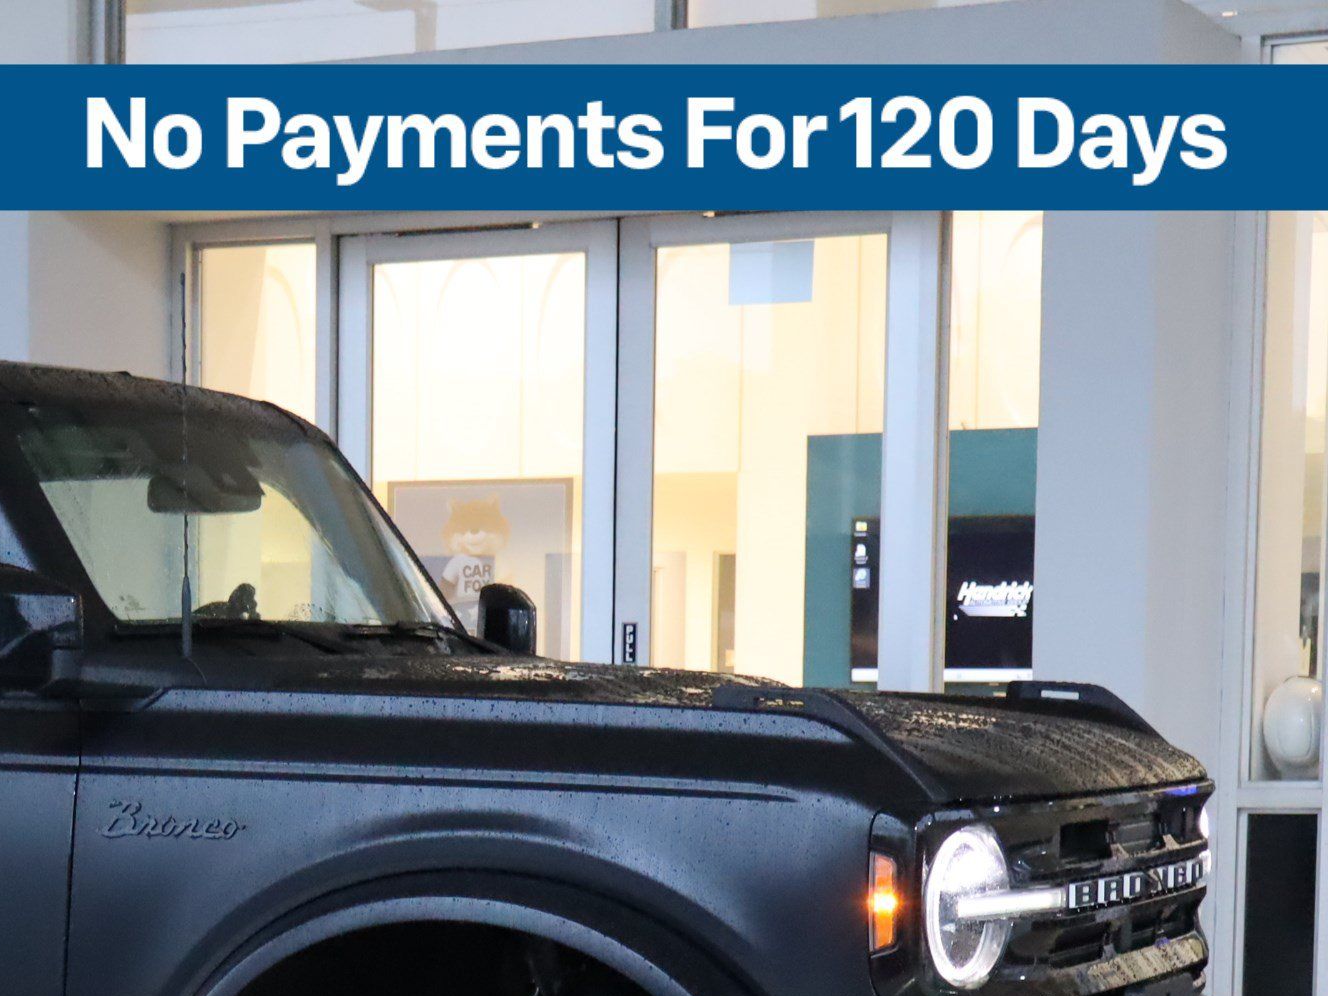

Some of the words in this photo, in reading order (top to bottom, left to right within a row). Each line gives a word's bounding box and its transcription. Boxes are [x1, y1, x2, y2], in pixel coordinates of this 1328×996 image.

[463, 564, 492, 578] CAR
[625, 624, 634, 662] PULL
[101, 799, 247, 840] Bronco
